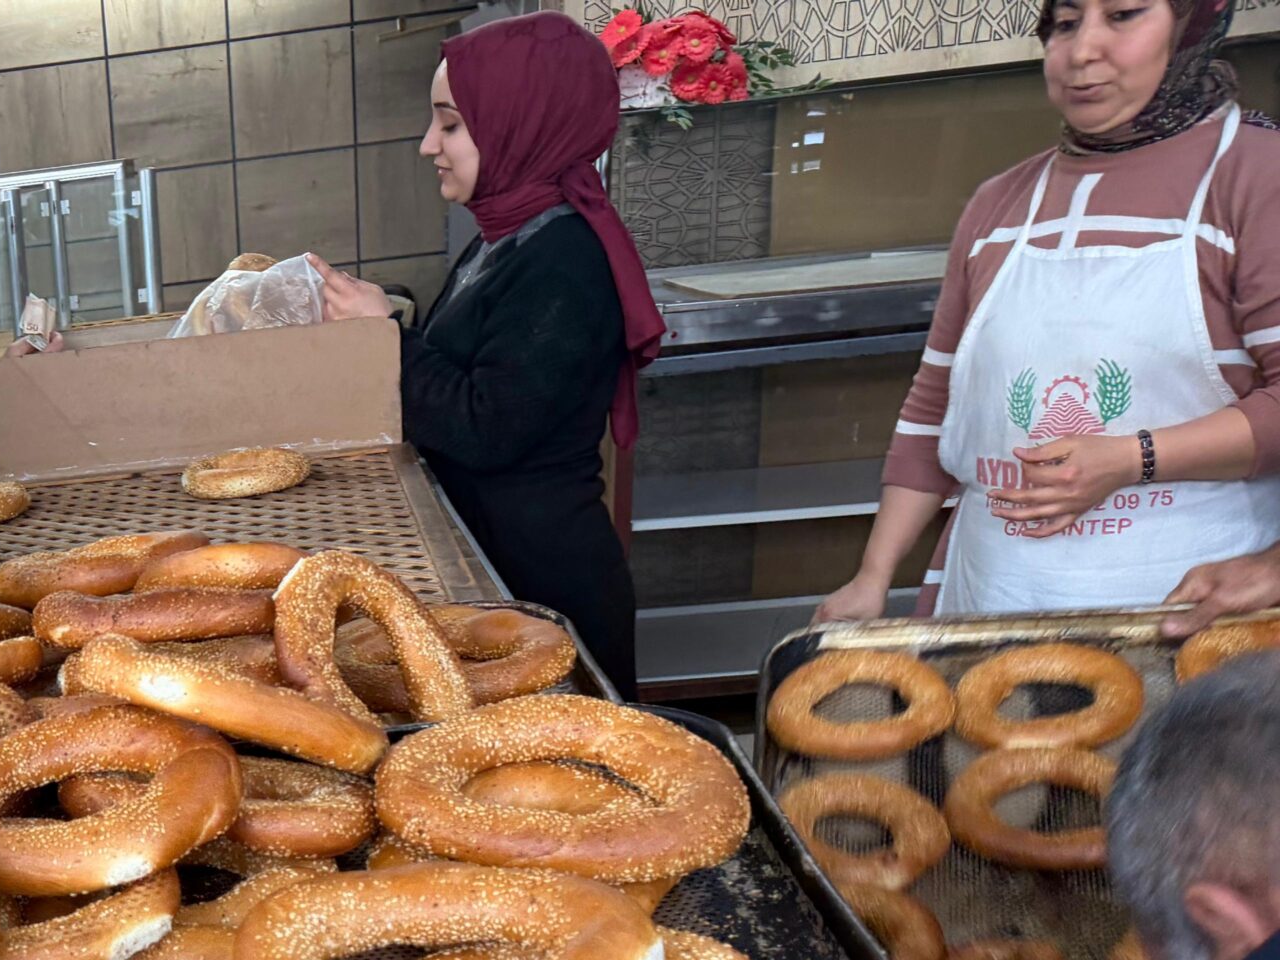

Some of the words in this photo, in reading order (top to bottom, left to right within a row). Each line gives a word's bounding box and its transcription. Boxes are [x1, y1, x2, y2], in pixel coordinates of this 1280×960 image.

[1113, 493, 1140, 510] 09
[1148, 490, 1173, 507] 75
[1004, 517, 1133, 537] GAZNTEP
